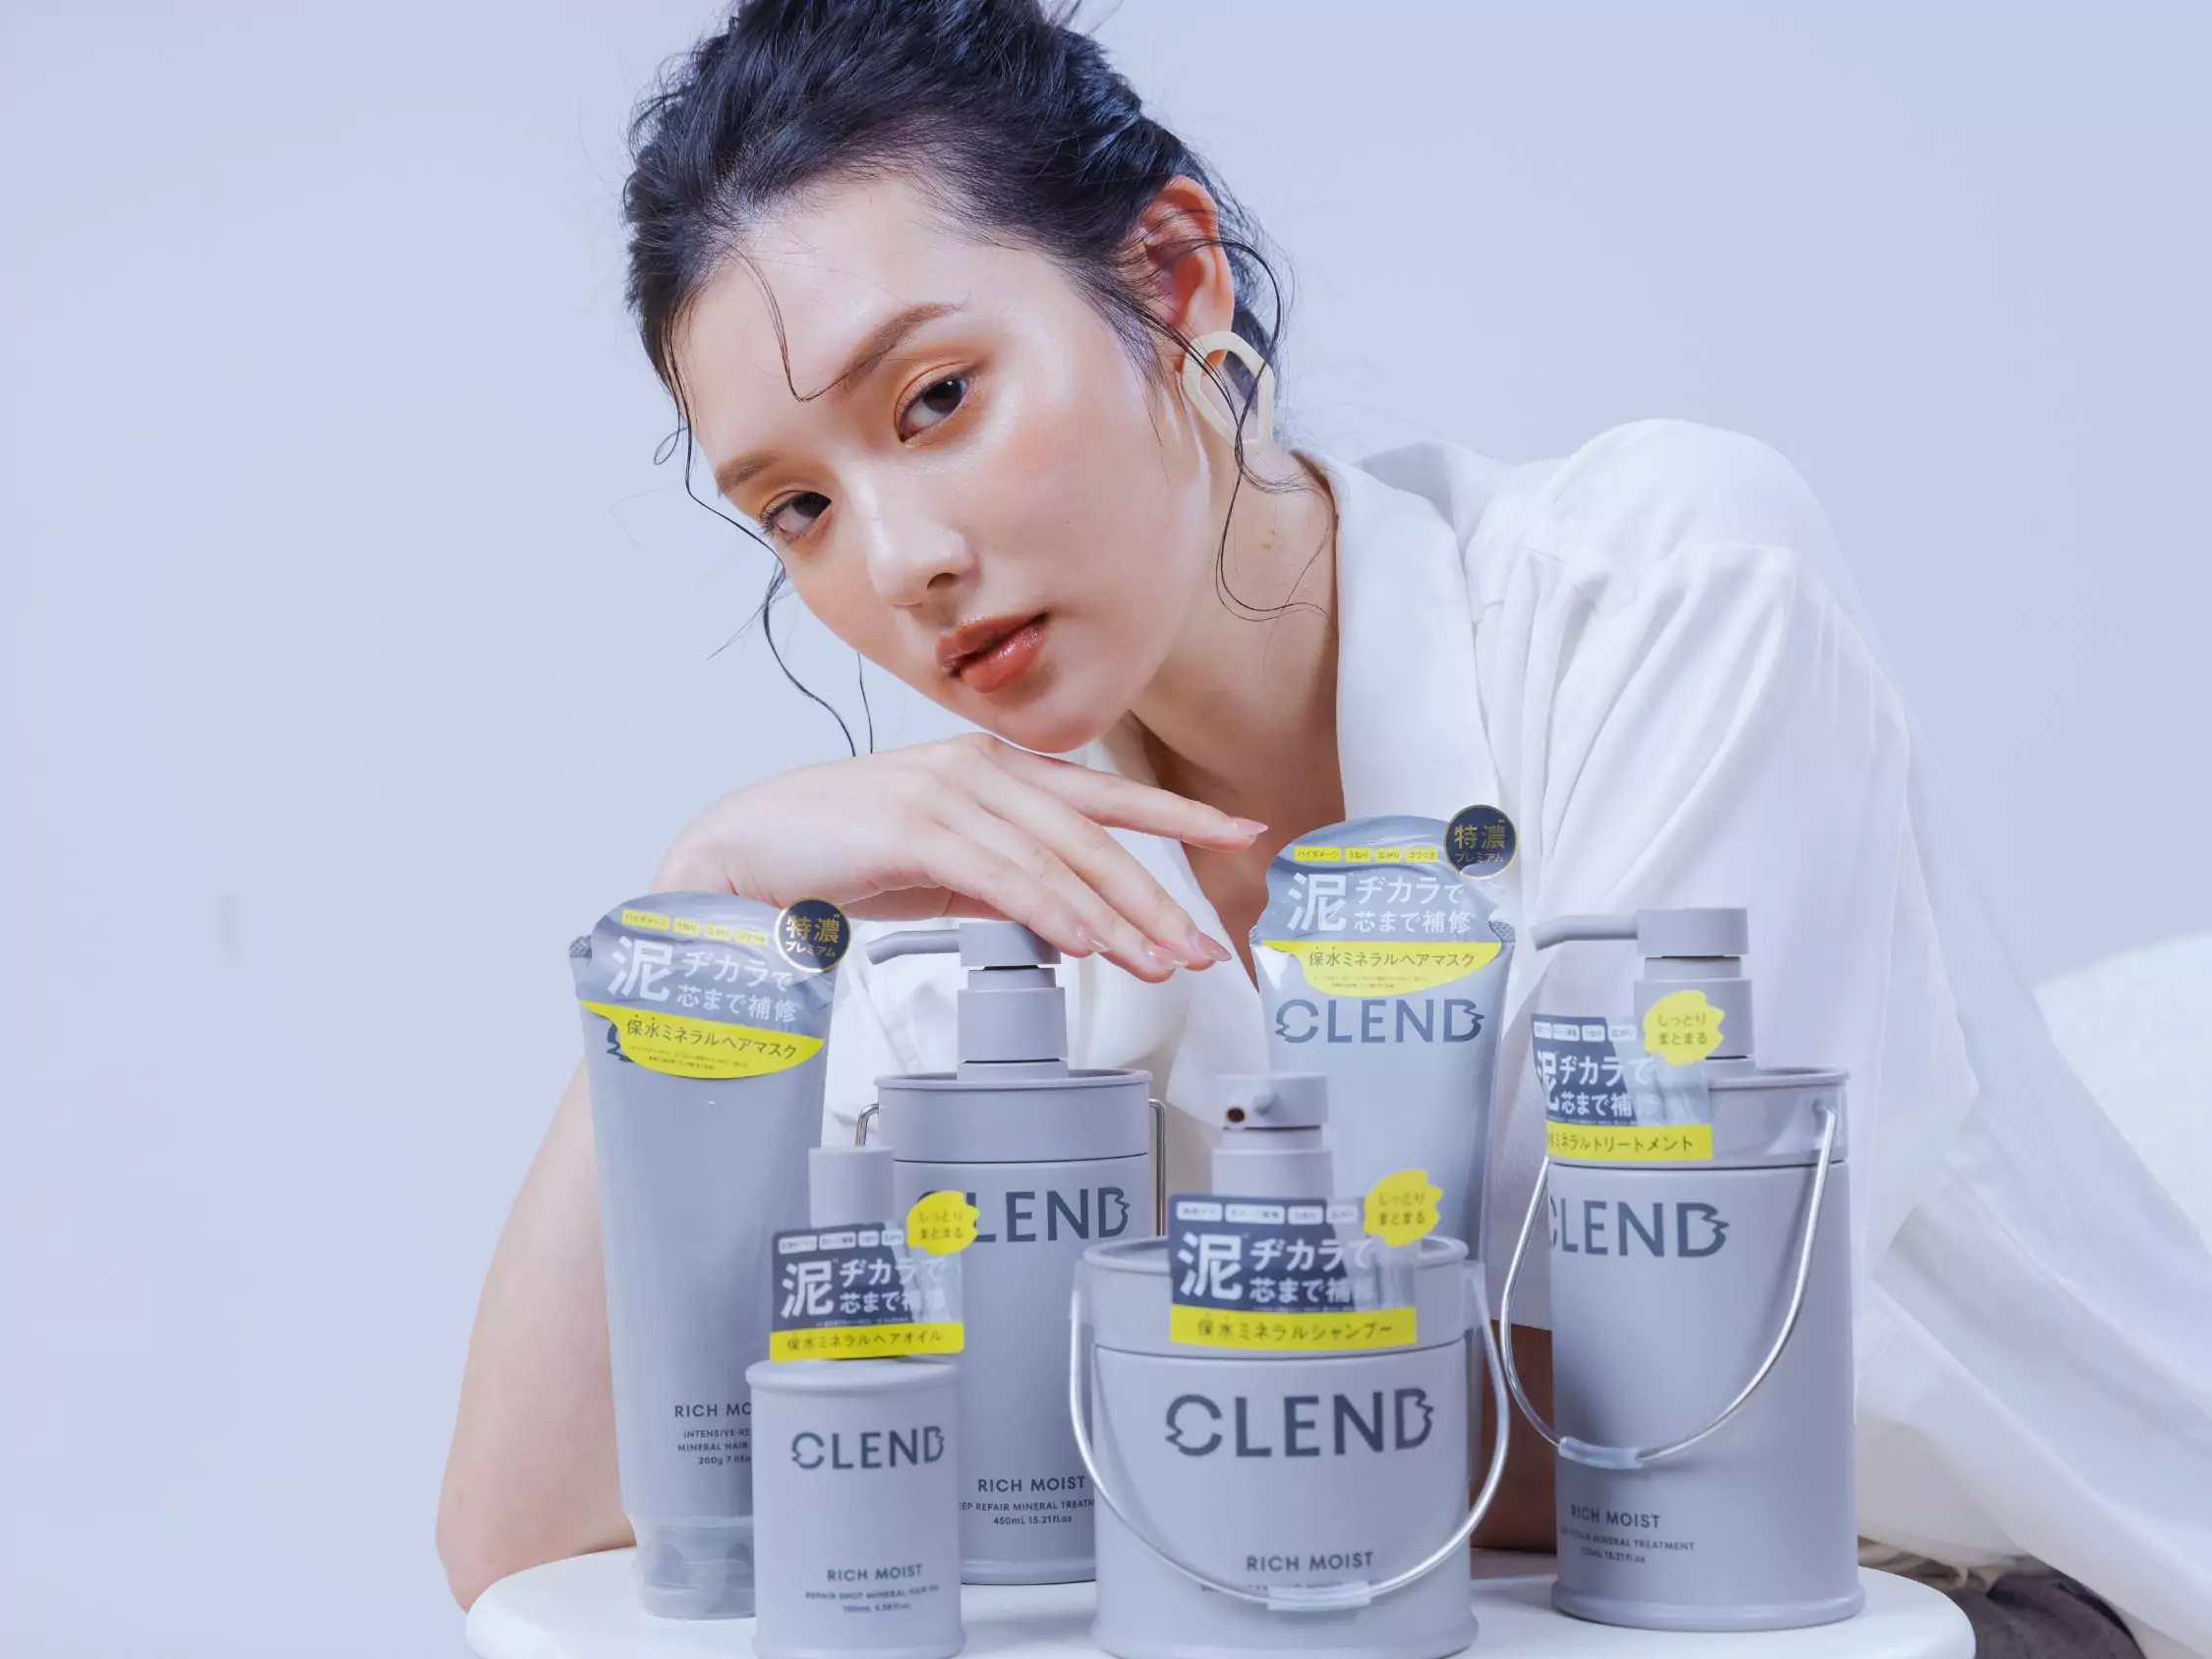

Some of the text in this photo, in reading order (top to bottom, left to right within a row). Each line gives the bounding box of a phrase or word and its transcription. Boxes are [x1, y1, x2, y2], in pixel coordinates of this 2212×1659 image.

[1454, 825, 1506, 849] 特濃
[1455, 852, 1504, 864] プレミアム
[1287, 872, 1347, 932] 泥
[786, 913, 841, 944] 特濃
[1354, 910, 1473, 934] 芯まで補修
[786, 941, 836, 957] プレミアム
[1309, 950, 1475, 967] 保水ミネラルヘアマスク
[607, 936, 673, 1001] 泥
[676, 984, 799, 1023] 芯まで補修
[1275, 999, 1485, 1043] CLEND
[1658, 1011, 1707, 1026] しっとり
[626, 1016, 797, 1060] 保水ミネラルヘアマスク
[1659, 1032, 1708, 1046] まとまる
[917, 1187, 1130, 1243] LEND
[1178, 1231, 1244, 1301] 泥
[781, 1259, 834, 1319] 泥
[787, 1331, 944, 1350] 保水ミネラルヘアオイル
[1198, 1320, 1392, 1343] 保水ミネラルシャンプー
[674, 1403, 718, 1418] RICH
[683, 1428, 735, 1439] INTENSIVE
[1165, 1388, 1434, 1458] CLEND
[677, 1441, 749, 1453] MINERAL HAIR
[791, 1425, 945, 1470] CLEND
[698, 1456, 724, 1466] 200g
[977, 1475, 1085, 1493] RICH MOIST
[975, 1502, 1010, 1512] REPAIR
[1013, 1501, 1058, 1513] MINERAL
[1570, 1504, 1660, 1529] RICH MOIST
[993, 1516, 1025, 1525] 450mL
[1593, 1533, 1631, 1548] MINERAL
[1633, 1538, 1695, 1551] TREATMENT
[826, 1564, 923, 1581] RICH MOIST
[1246, 1551, 1373, 1573] RICH MOIST
